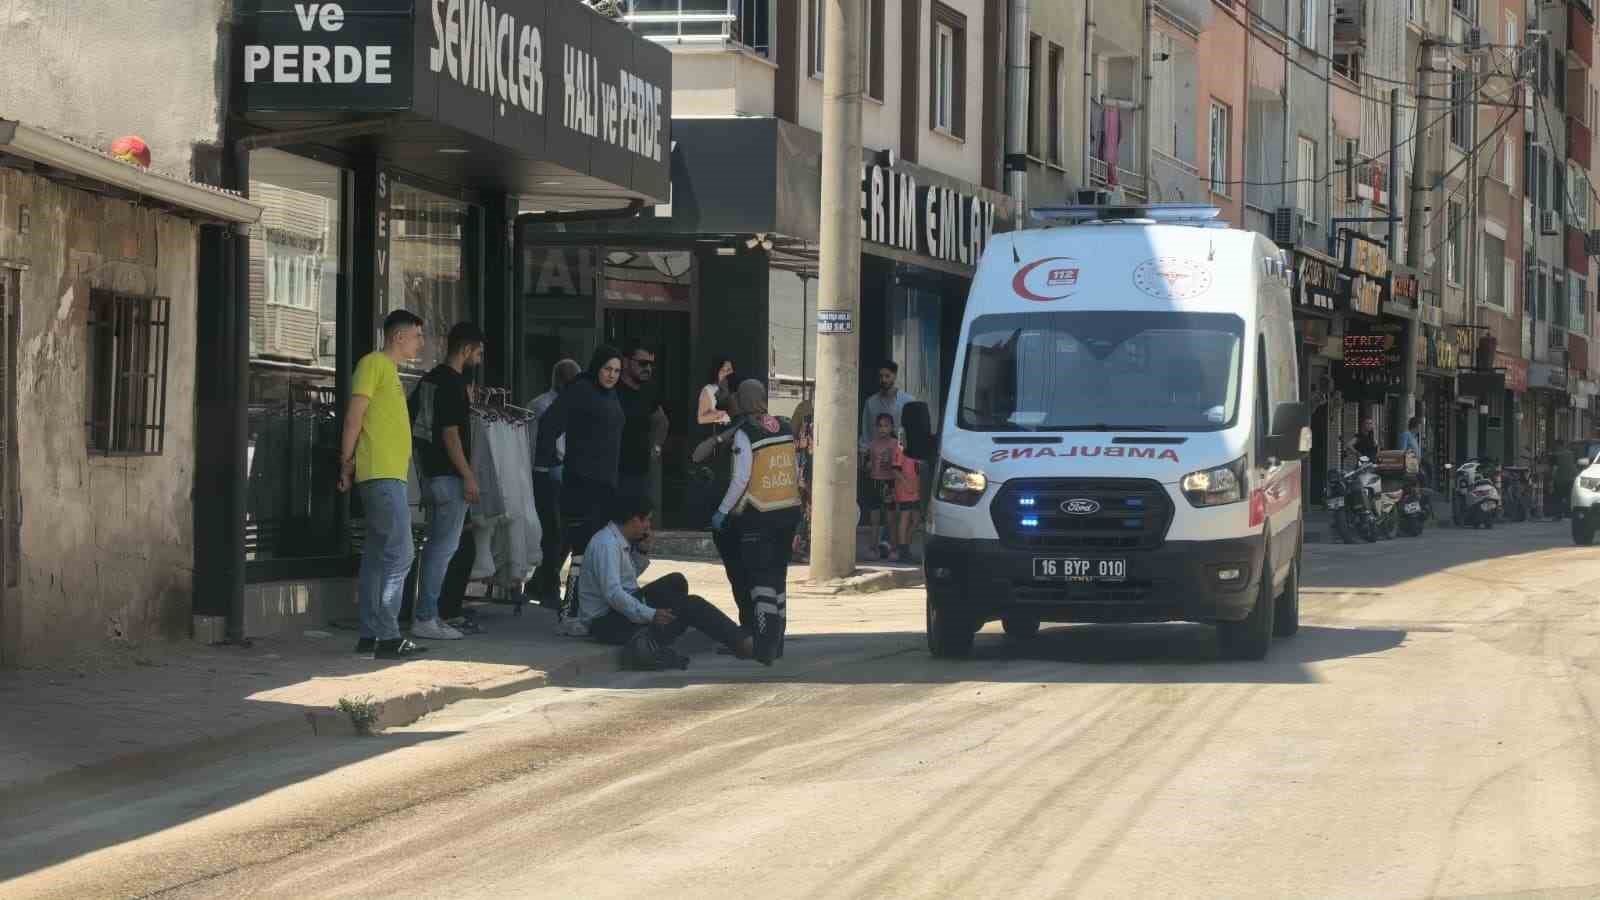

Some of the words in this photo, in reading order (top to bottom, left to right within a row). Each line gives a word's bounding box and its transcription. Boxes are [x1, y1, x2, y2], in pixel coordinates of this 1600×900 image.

[294, 3, 345, 32] ve
[244, 45, 392, 84] PERDE
[563, 43, 598, 138] HALI
[601, 81, 617, 145] ve
[620, 69, 662, 162] PERDE
[926, 185, 995, 266] EMLAK
[1052, 270, 1075, 280] 112
[1067, 501, 1094, 513] Ford
[1042, 560, 1057, 575] 16
[1064, 560, 1090, 575] BYP
[1099, 560, 1123, 576] 010
